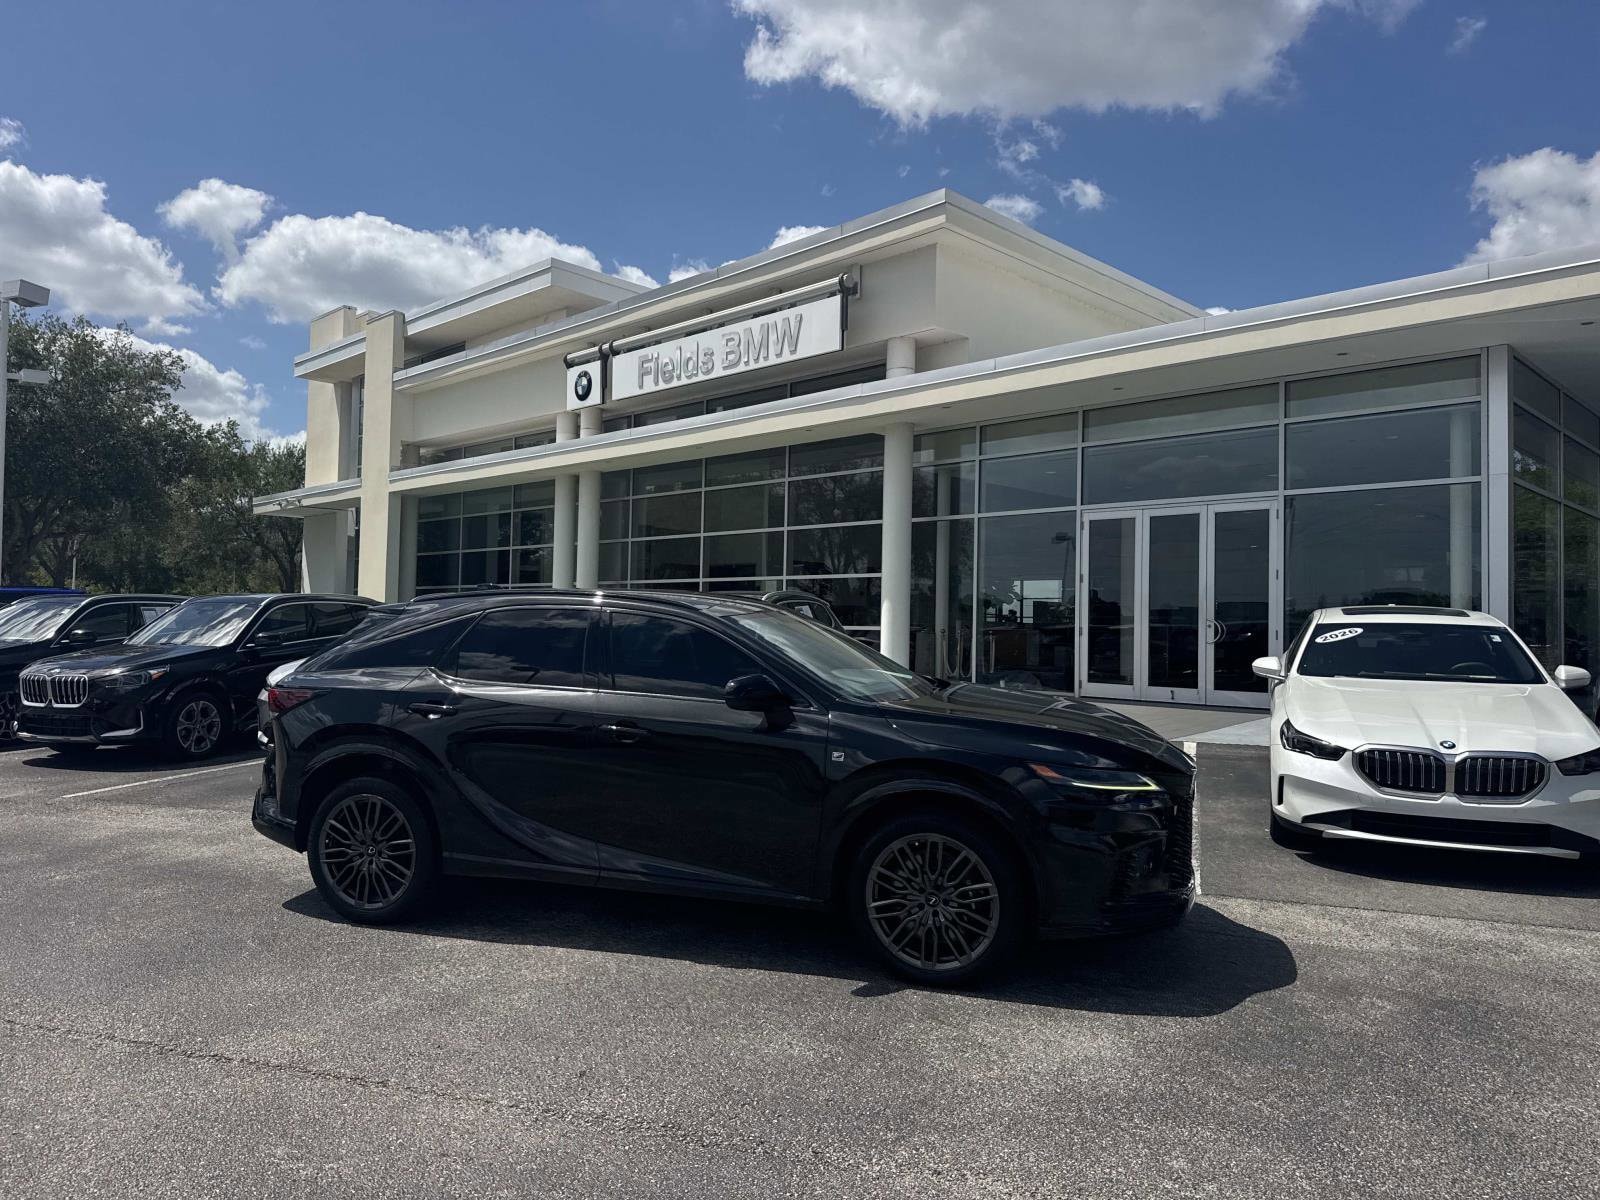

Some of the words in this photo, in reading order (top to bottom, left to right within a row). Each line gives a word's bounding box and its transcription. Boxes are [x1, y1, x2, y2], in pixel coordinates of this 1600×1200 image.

[637, 340, 715, 389] Fields
[721, 313, 803, 370] BMW
[1320, 628, 1358, 641] 2026
